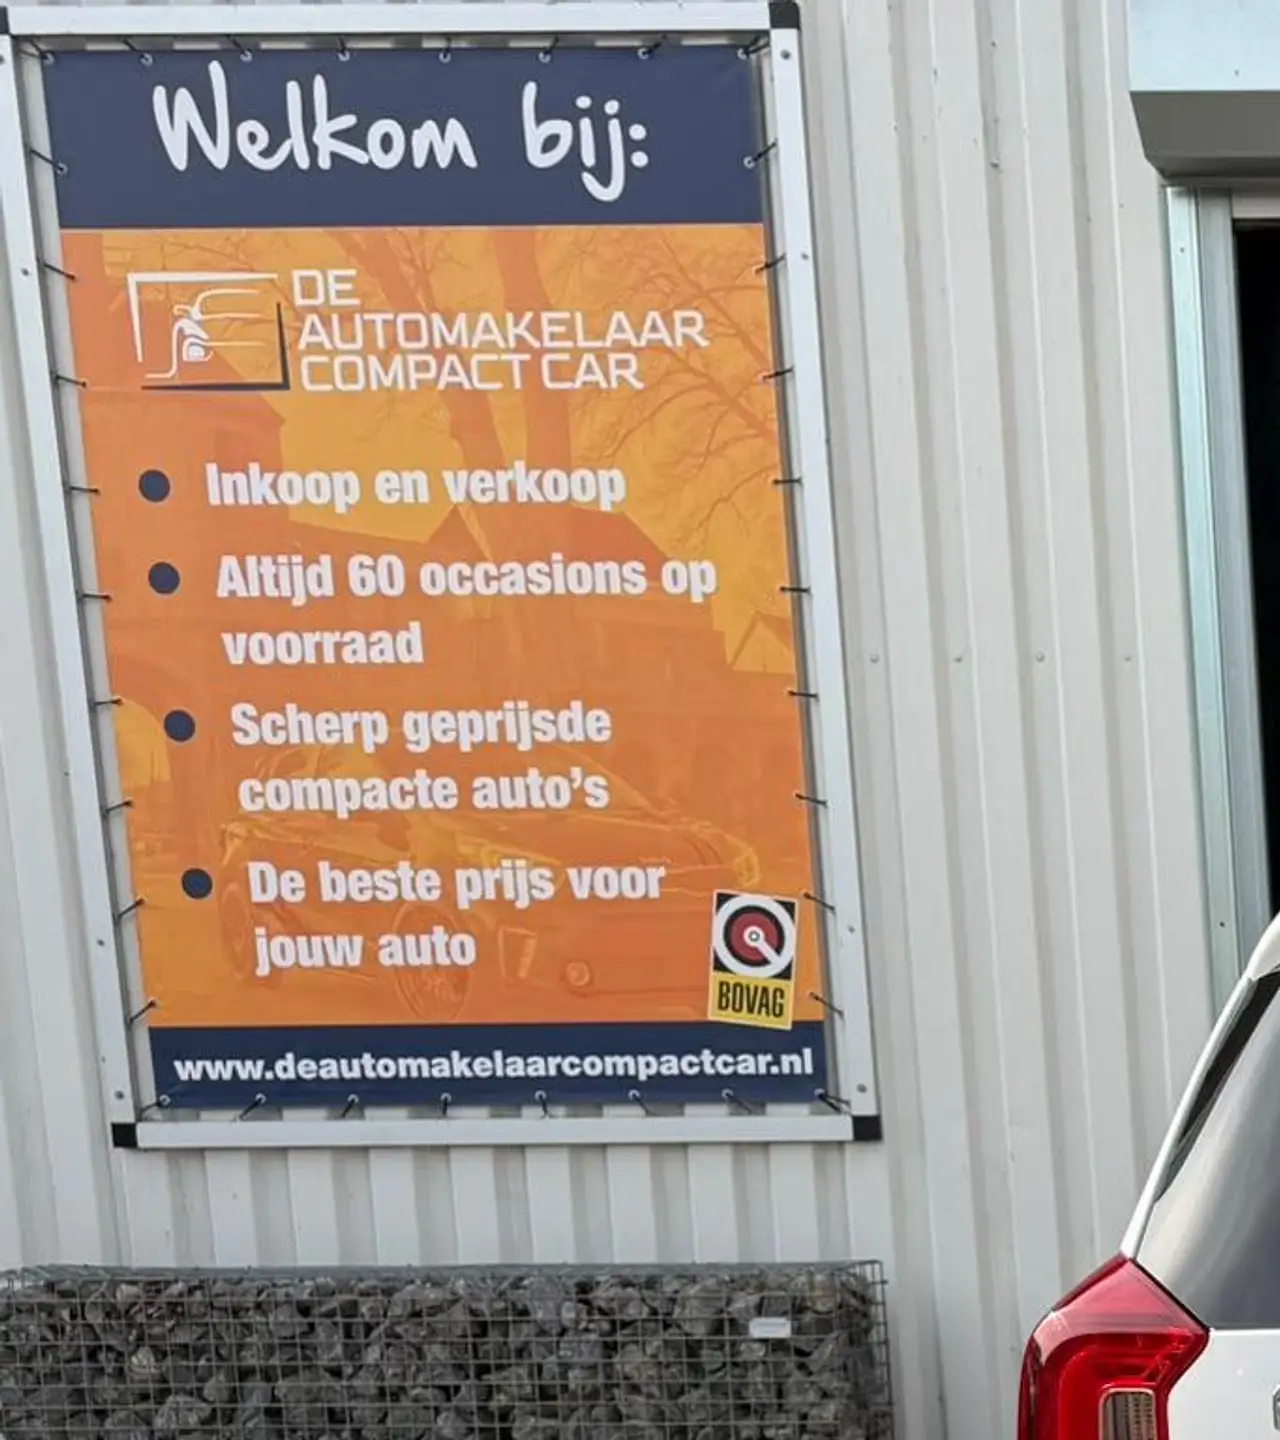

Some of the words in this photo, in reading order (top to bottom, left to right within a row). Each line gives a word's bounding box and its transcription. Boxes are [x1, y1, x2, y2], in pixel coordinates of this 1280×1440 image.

[152, 60, 479, 172] Welkom
[521, 81, 649, 201] bij:
[291, 268, 358, 307] DE
[298, 310, 708, 351] AUTOMAKELAAR
[300, 354, 530, 392] COMPACT
[540, 354, 645, 389] CAR
[206, 463, 361, 513] Inkoop
[375, 469, 430, 504] en
[443, 461, 626, 510] verkoop
[216, 553, 333, 606] Altijd
[348, 555, 404, 597] 60
[419, 552, 646, 597] occasions
[661, 559, 716, 603] op
[222, 622, 424, 665] voorraad
[230, 702, 388, 752] Scherp
[403, 700, 612, 748] geprijsde
[239, 772, 458, 818] compacte
[472, 766, 609, 809] auto's
[247, 861, 307, 903] De
[319, 860, 441, 903] beste
[456, 859, 555, 907] prijs
[566, 860, 666, 899] voor
[253, 928, 363, 976] jouw
[378, 926, 477, 967] auto
[718, 981, 785, 1018] BOVAG
[174, 1048, 814, 1081] www.deautomakelaarcompactcar.nl
